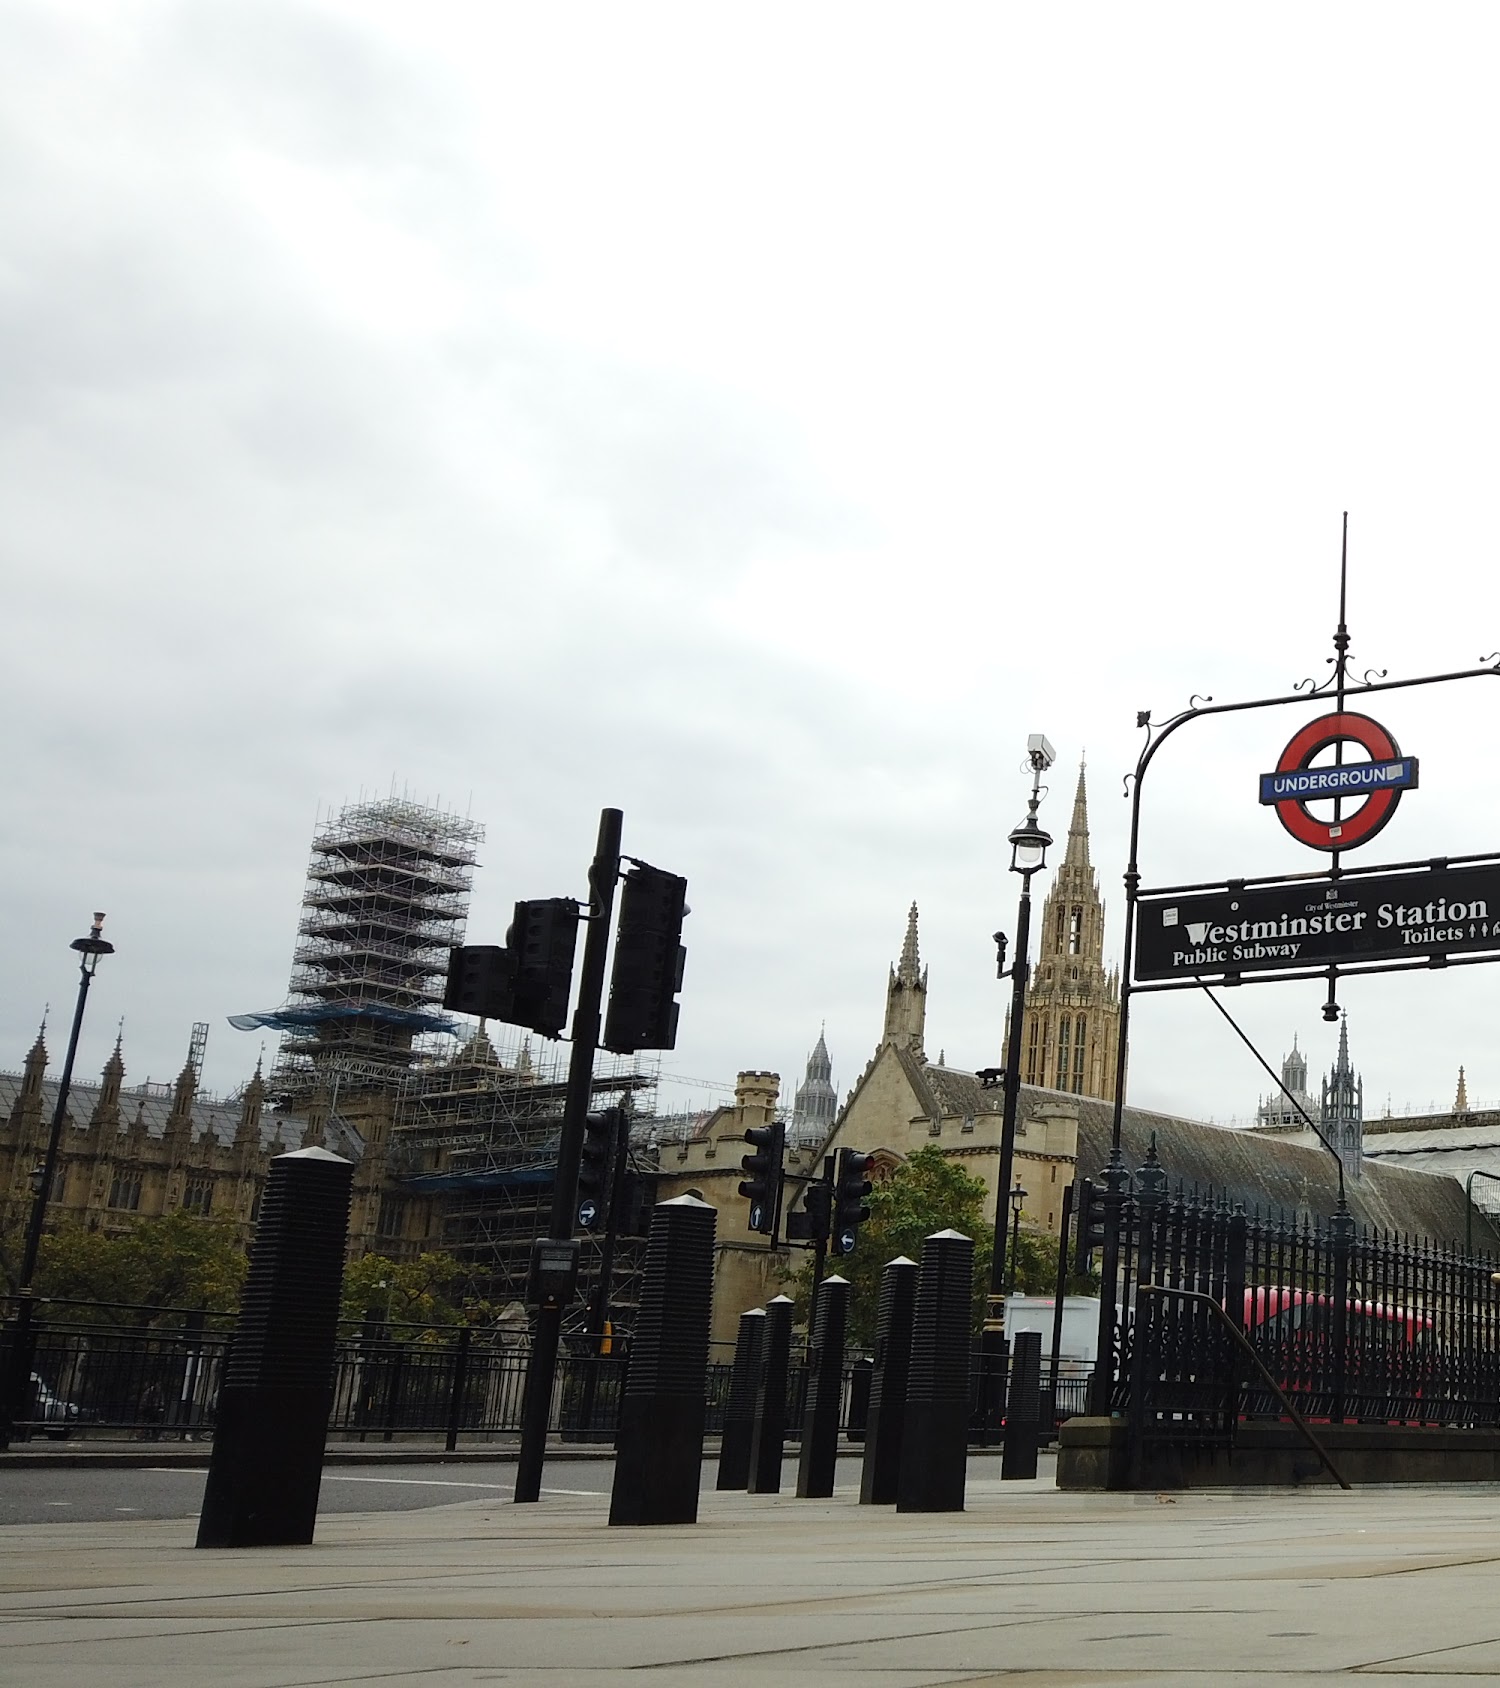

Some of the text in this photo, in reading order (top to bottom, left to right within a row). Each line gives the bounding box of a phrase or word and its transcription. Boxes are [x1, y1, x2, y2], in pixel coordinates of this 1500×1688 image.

[1316, 902, 1324, 911] of
[1376, 897, 1489, 929] Station
[1400, 925, 1464, 945] Toilets
[1172, 942, 1302, 967] Public Subway
